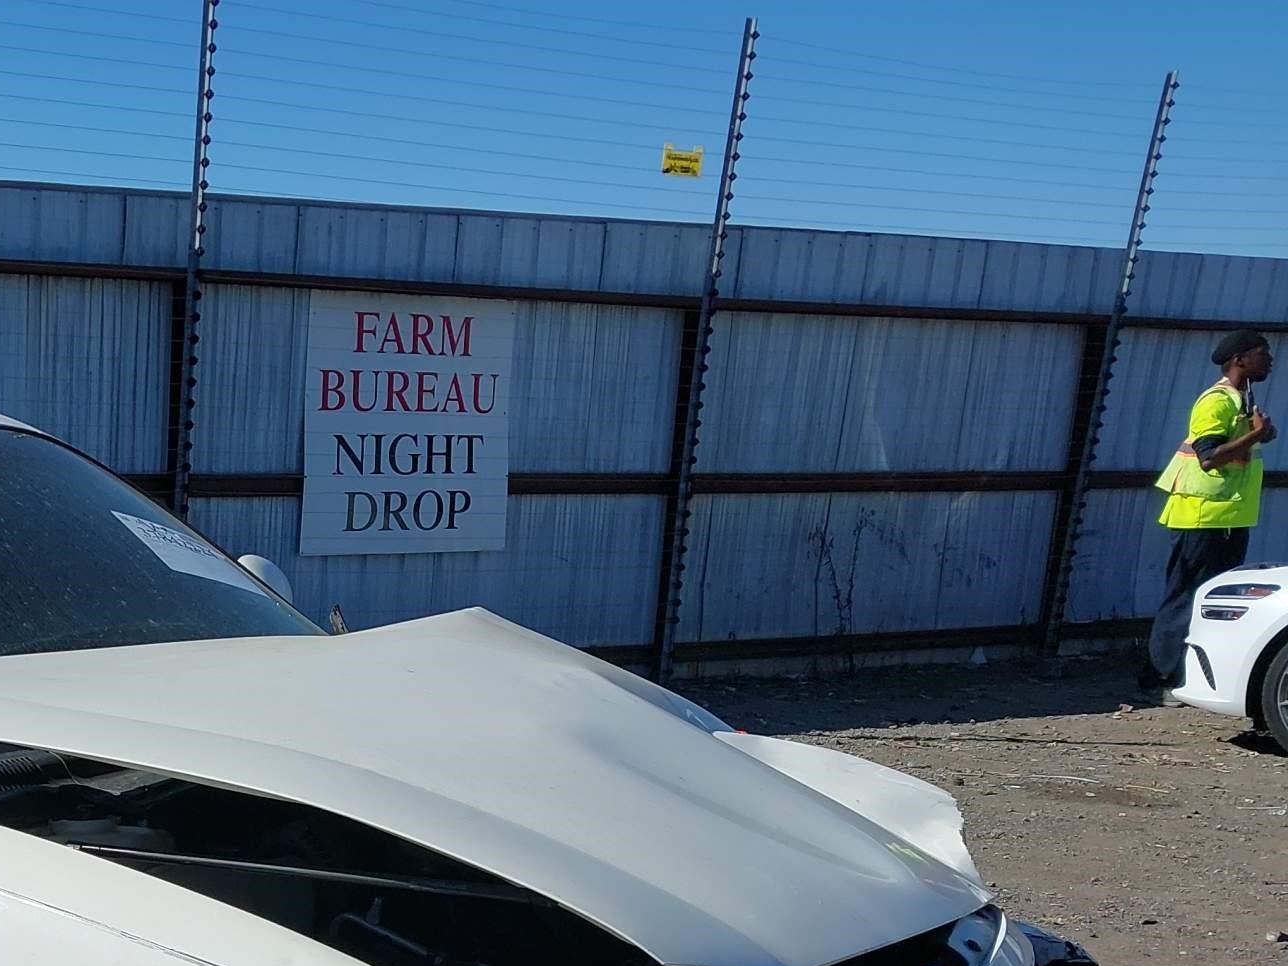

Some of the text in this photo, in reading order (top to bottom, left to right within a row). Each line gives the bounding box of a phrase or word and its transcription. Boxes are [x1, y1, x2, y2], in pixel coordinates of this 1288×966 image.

[353, 312, 475, 357] FARM
[318, 369, 499, 414] BUREAU
[332, 433, 484, 475] NIGHT
[343, 490, 472, 531] DROP
